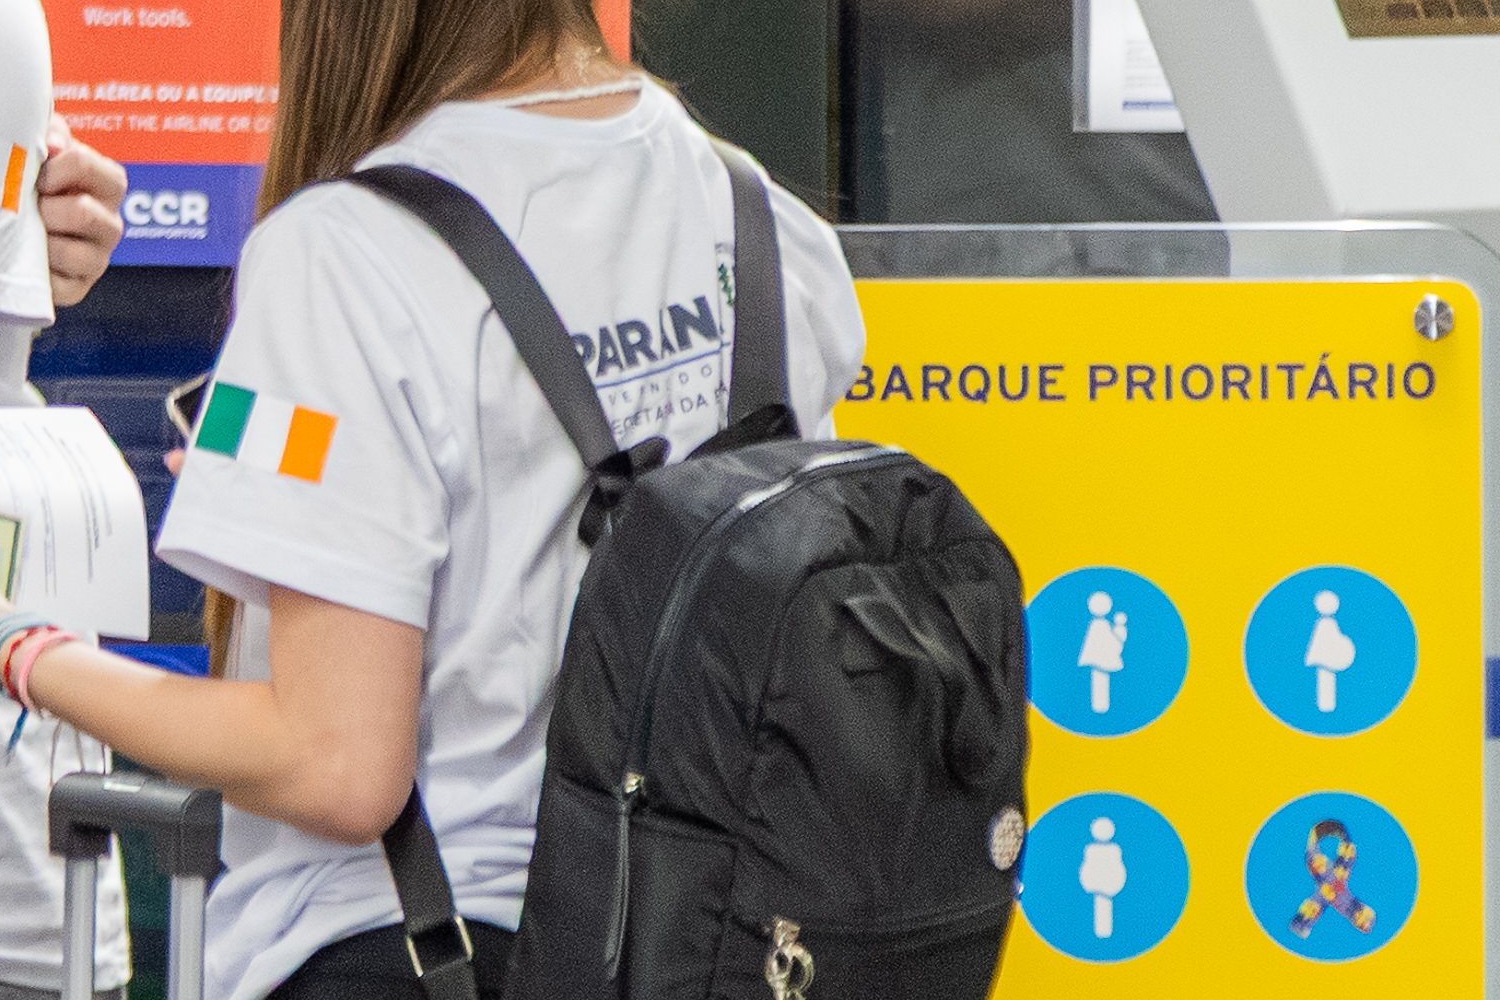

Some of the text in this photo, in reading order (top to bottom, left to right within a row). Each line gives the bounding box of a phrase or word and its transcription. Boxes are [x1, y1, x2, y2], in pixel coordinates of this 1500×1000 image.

[84, 8, 192, 28] Work tools.
[128, 115, 158, 132] THE
[124, 189, 209, 226] CCR
[844, 353, 1438, 404] BARQUE PRIORITÁRIO
